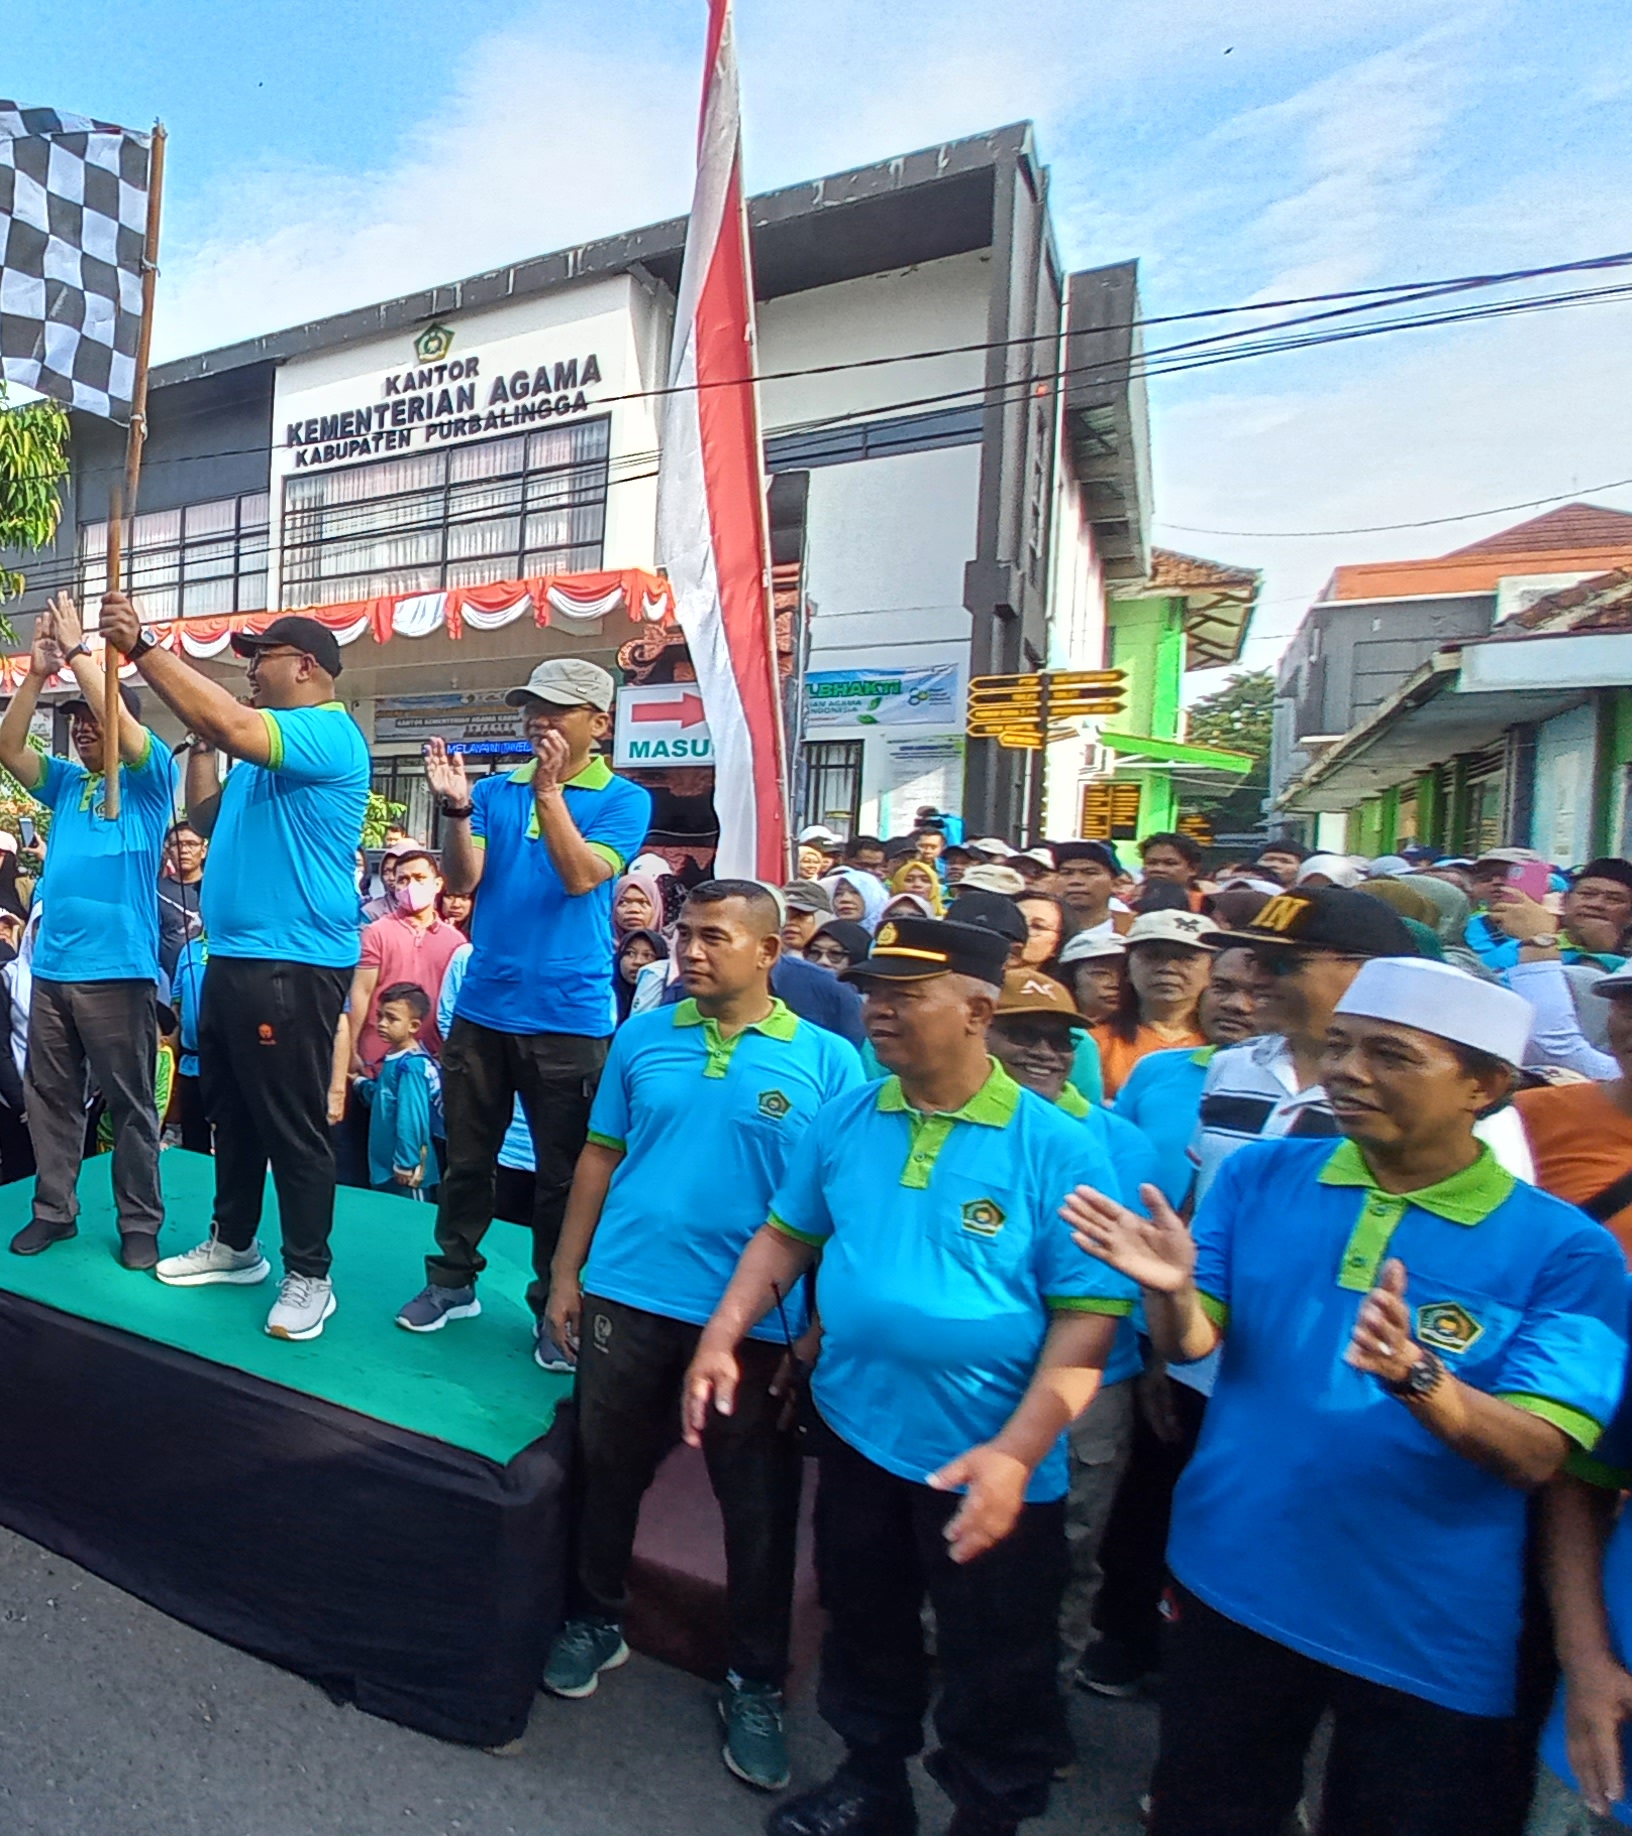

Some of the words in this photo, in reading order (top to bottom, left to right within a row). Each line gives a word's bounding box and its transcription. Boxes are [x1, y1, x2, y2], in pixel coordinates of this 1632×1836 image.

[285, 382, 476, 447] KEMENTERIAN
[490, 354, 602, 404] AGAMA
[384, 356, 480, 396] KANTOR
[294, 428, 412, 468] KABUPATEN
[424, 391, 588, 443] PURBALINGGA
[628, 739, 710, 759] MASU
